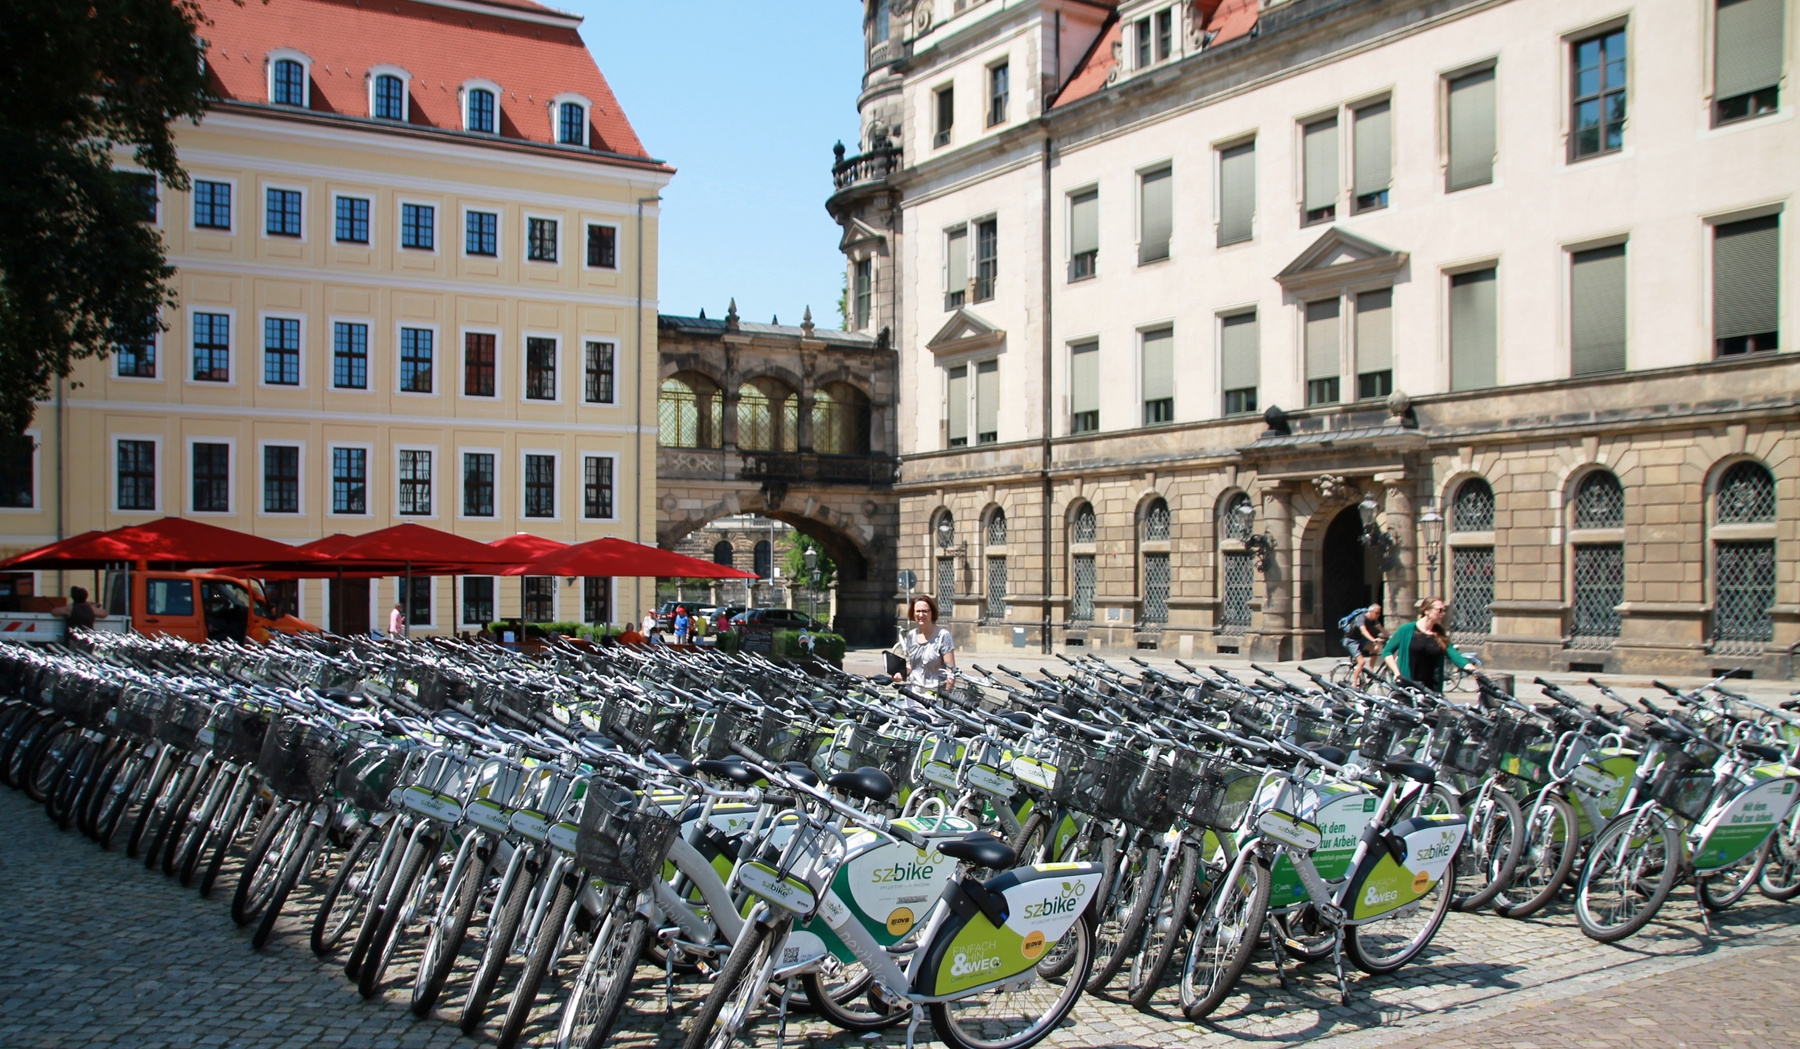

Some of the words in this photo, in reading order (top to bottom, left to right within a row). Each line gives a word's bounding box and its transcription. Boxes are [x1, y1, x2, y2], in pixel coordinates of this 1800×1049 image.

[1328, 821, 1346, 834] dem
[1333, 834, 1357, 848] Arbeit
[952, 940, 997, 958] EINFACH
[840, 931, 887, 983] nextbike
[966, 951, 984, 963] HIN
